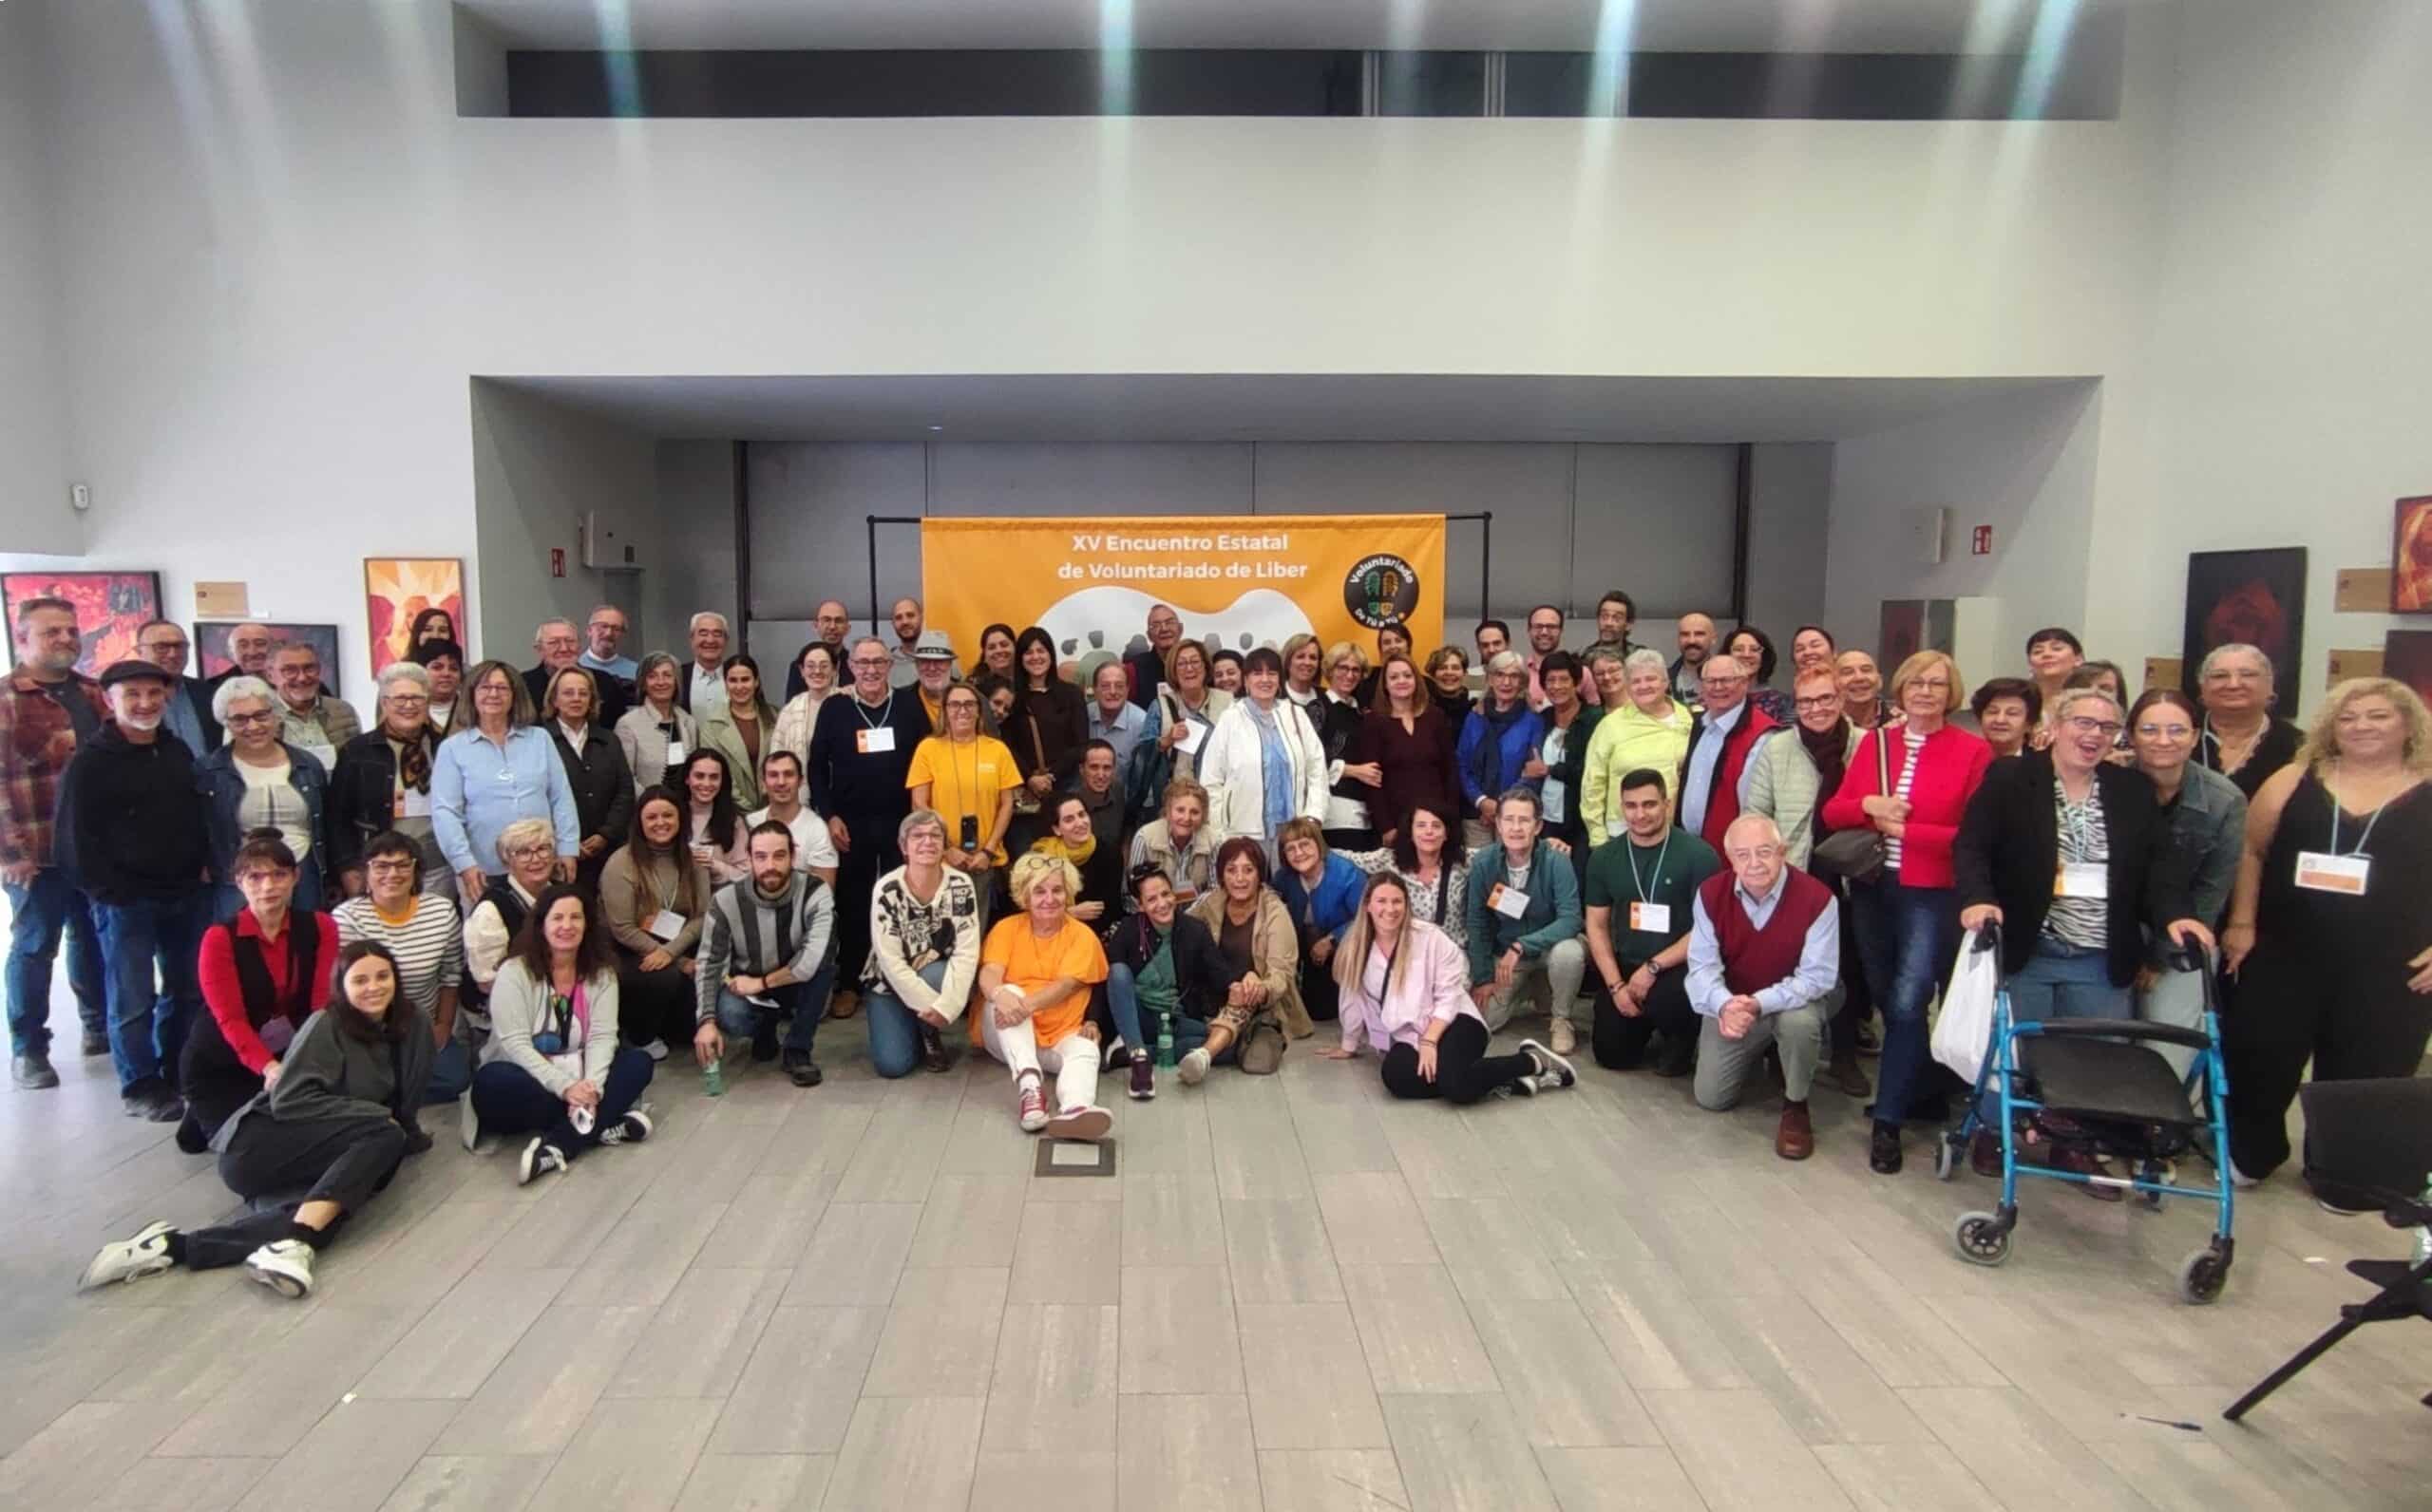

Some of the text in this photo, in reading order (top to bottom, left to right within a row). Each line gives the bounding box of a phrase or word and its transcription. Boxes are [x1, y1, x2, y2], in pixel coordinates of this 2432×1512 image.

[1072, 533, 1289, 552] XV Encuentro Estatal
[1057, 560, 1308, 579] de Voluntariado de Liber
[1349, 557, 1414, 584] Voluntariado
